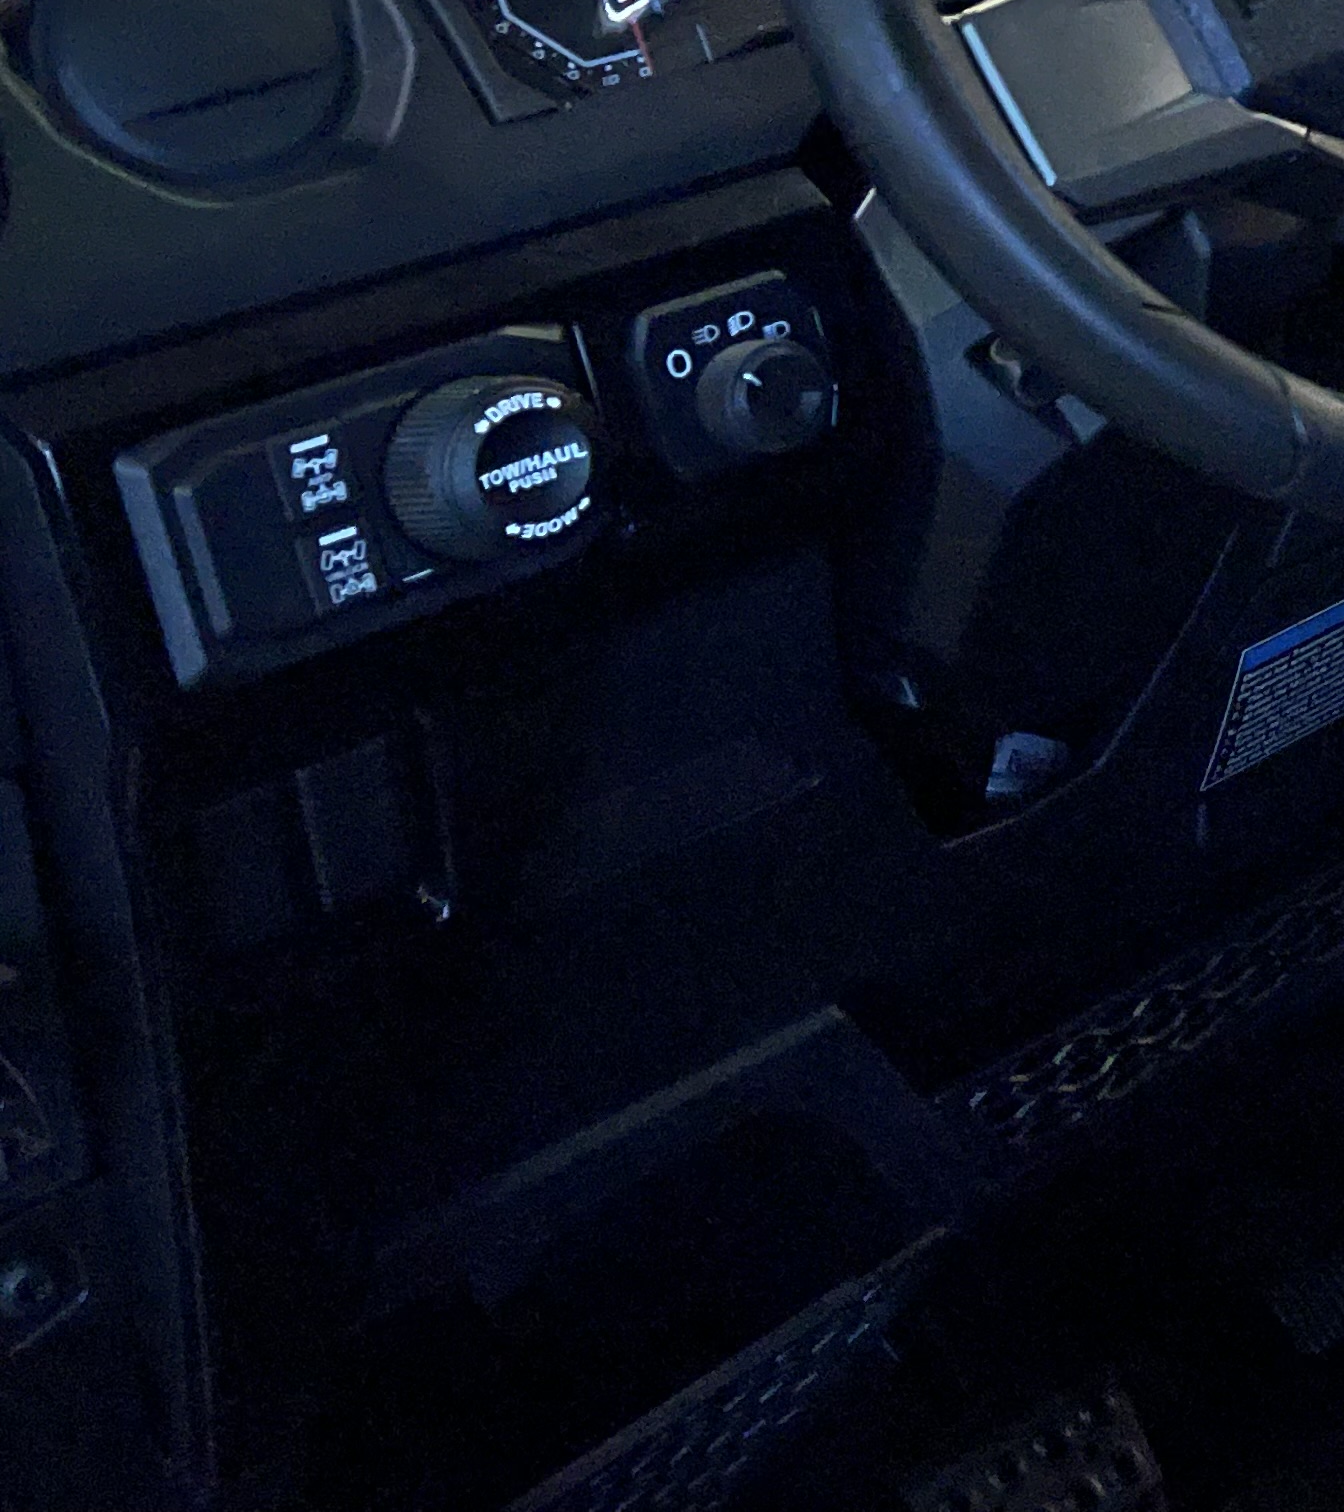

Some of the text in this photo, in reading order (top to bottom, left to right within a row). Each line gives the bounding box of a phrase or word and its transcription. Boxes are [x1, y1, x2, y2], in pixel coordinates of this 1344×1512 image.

[484, 392, 544, 423] DRIVE
[478, 442, 589, 490] TOW/HAUL
[508, 466, 558, 493] PUSH
[520, 506, 578, 539] MODE
